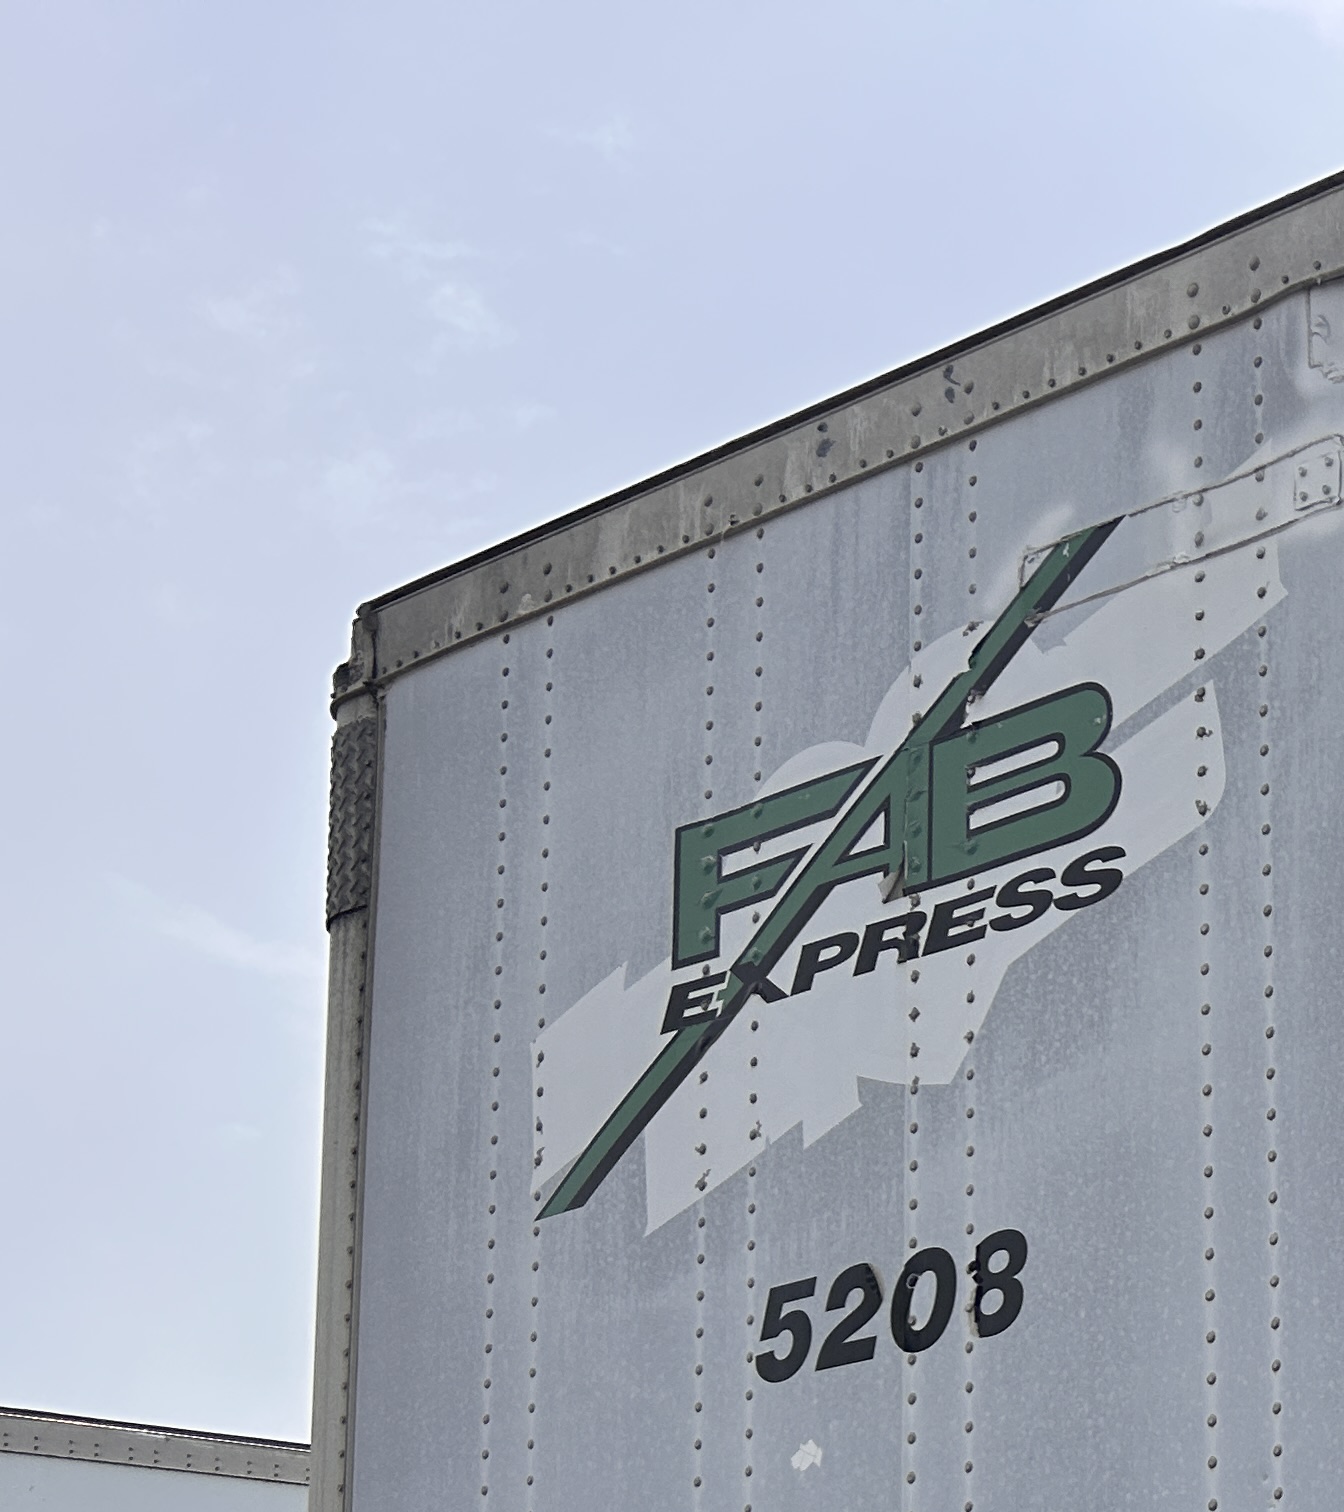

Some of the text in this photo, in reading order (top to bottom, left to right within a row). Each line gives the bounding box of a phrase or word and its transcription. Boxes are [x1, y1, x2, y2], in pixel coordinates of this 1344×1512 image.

[671, 681, 1123, 971] FAB
[660, 846, 1128, 1035] EXPRESS
[755, 1228, 1028, 1383] 5208
